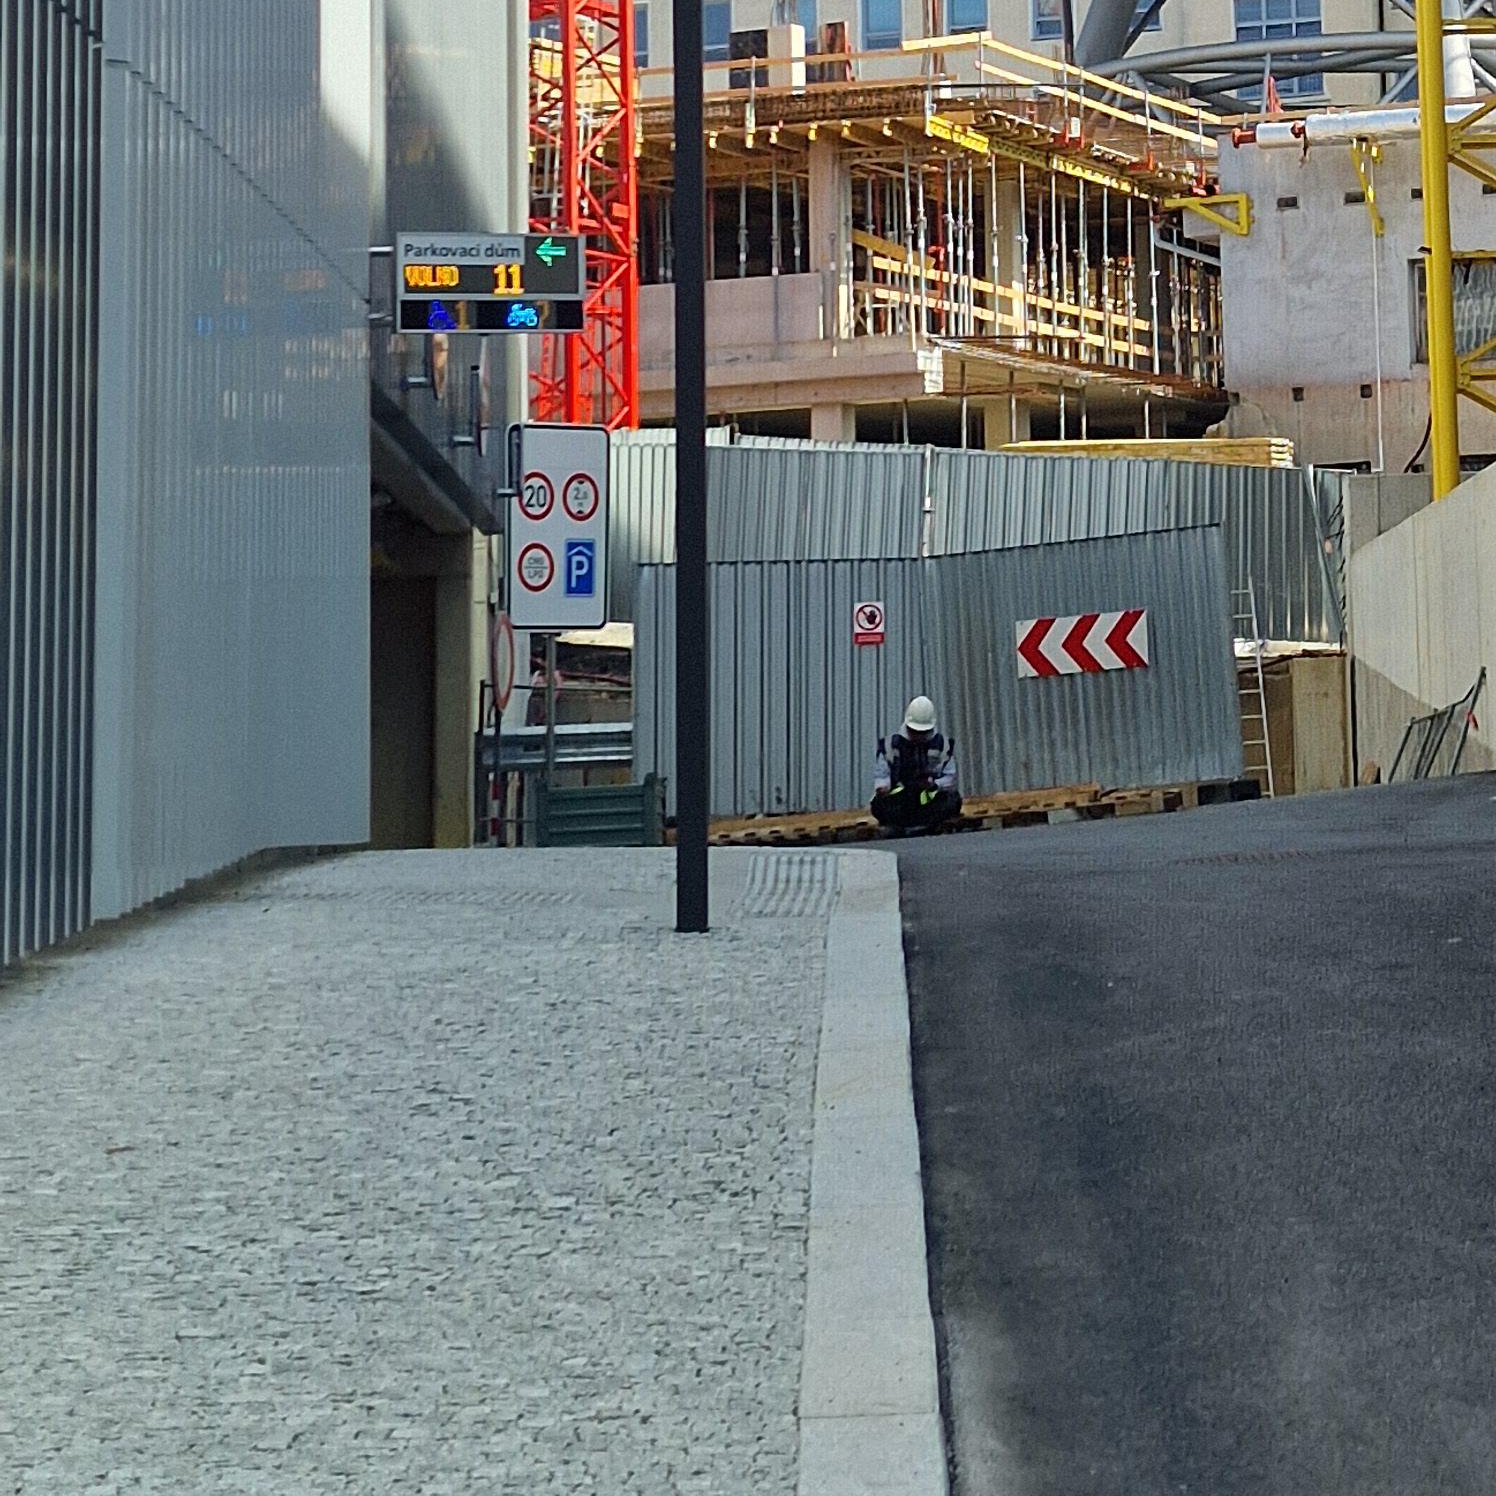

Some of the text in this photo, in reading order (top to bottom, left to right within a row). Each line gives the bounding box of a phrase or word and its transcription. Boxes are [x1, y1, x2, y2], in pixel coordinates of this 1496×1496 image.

[403, 241, 521, 258] Parkovací dům
[493, 263, 526, 295] 11
[525, 484, 547, 508] 20
[571, 555, 590, 588] P
